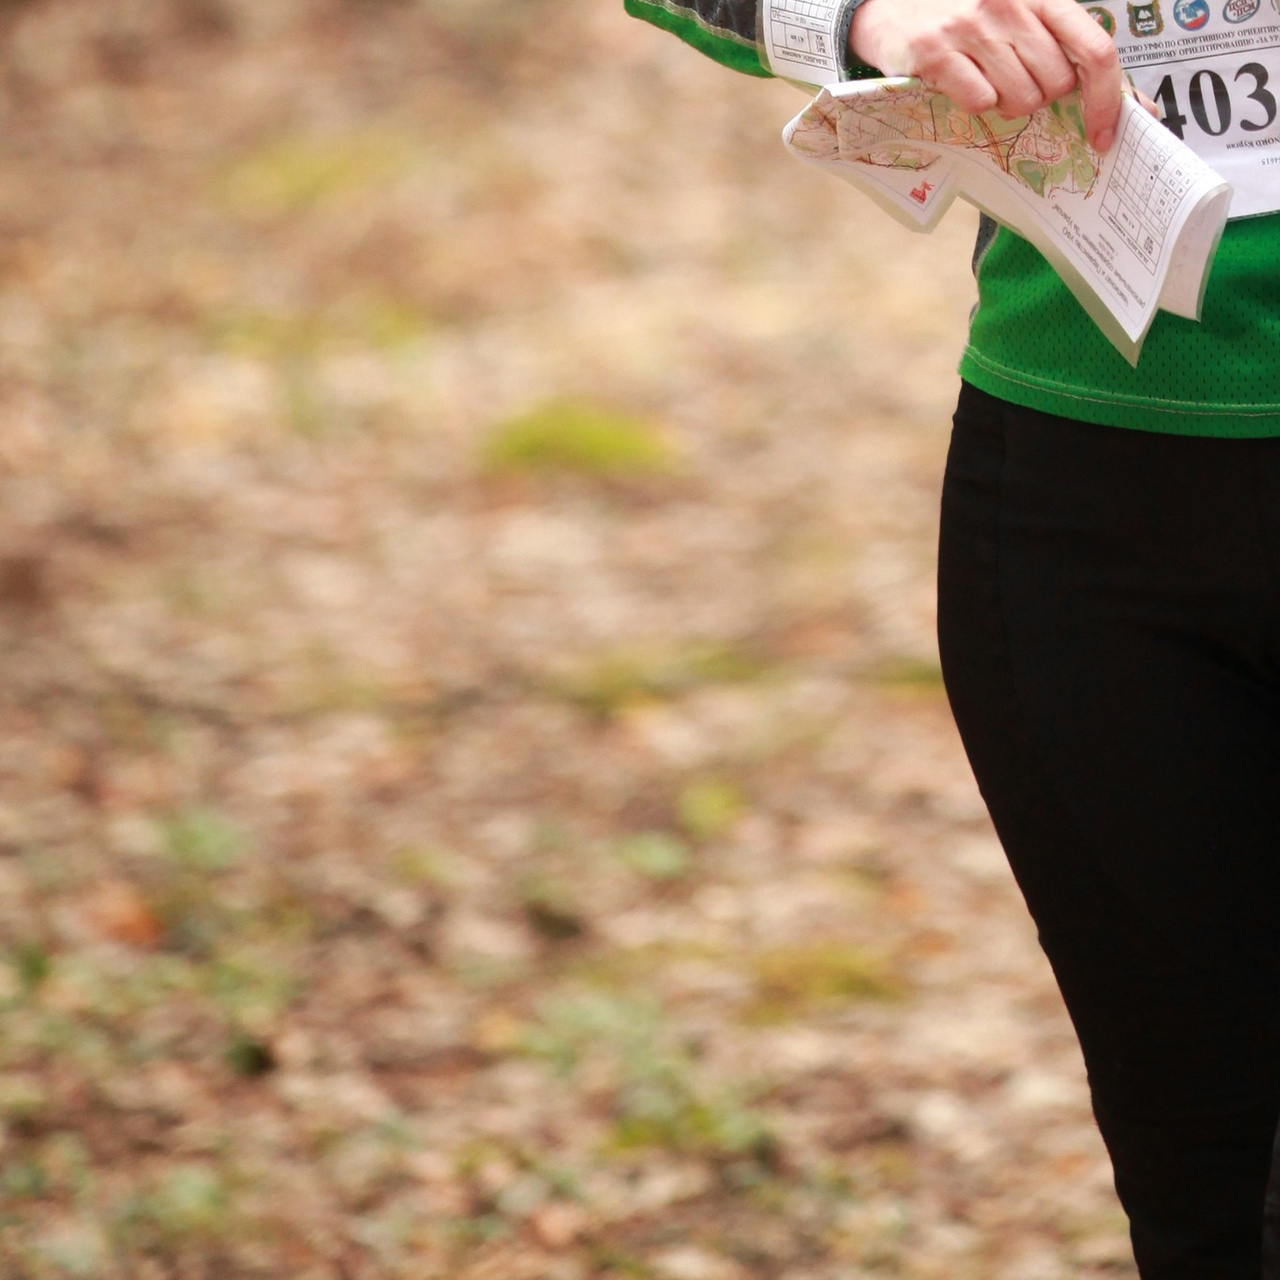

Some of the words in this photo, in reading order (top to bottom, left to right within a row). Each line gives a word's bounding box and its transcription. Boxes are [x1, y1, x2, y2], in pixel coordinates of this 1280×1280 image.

[1117, 44, 1143, 55] НСТВО
[1143, 41, 1165, 53] УРФО
[1165, 40, 1177, 50] ПО
[1177, 30, 1237, 48] СПОРТИВНОМУ
[1122, 49, 1178, 65] СПОРТИВНОМУ
[1179, 38, 1255, 58] ОРИЕНТИРОВАНИЮ
[1153, 62, 1277, 140] 403
